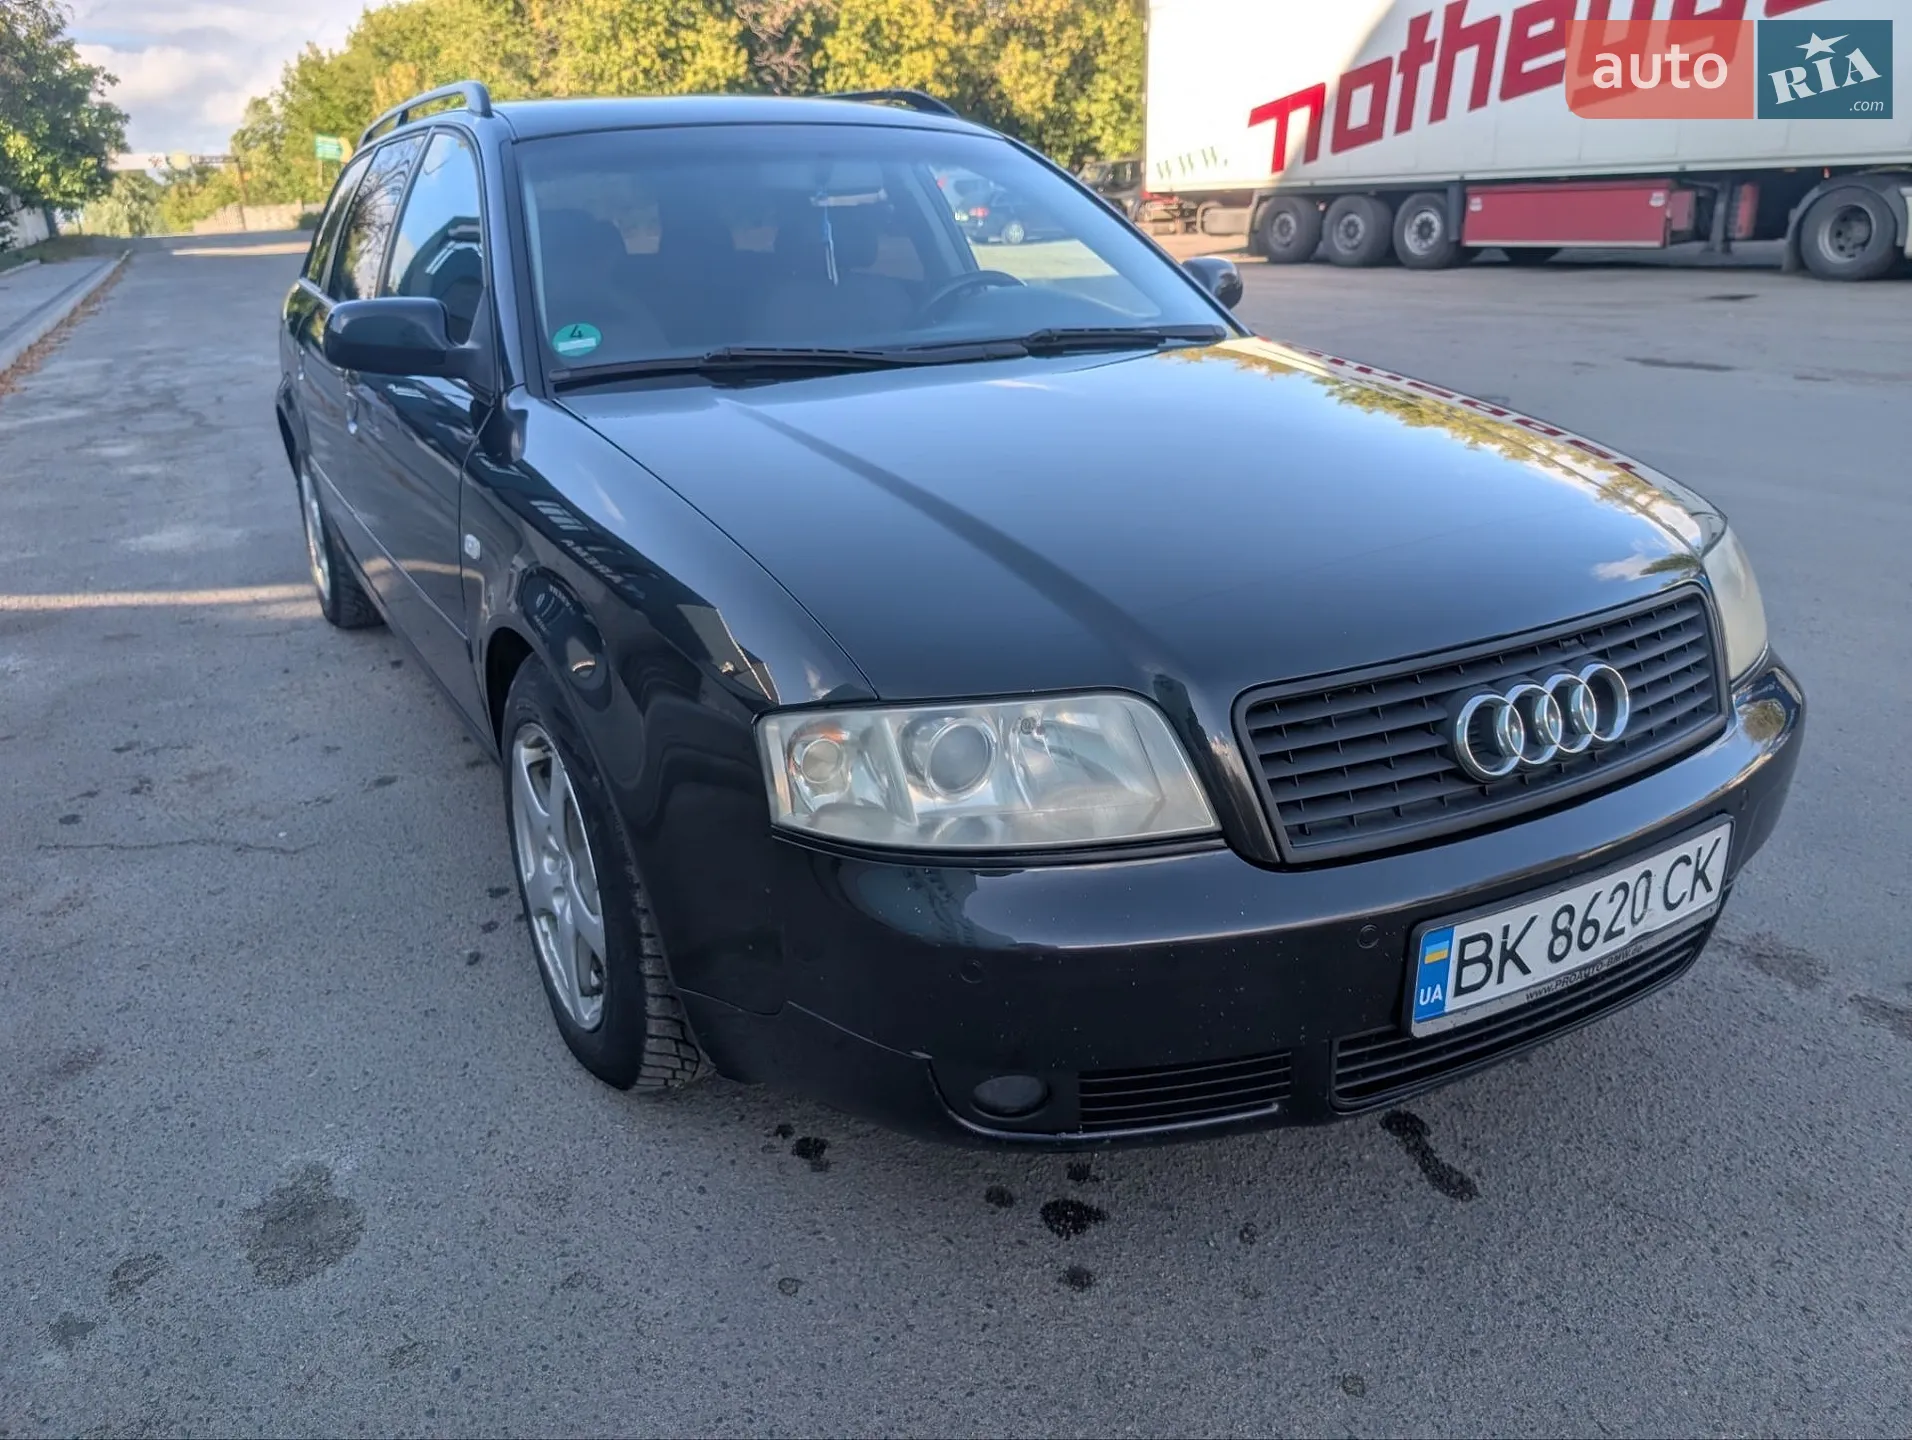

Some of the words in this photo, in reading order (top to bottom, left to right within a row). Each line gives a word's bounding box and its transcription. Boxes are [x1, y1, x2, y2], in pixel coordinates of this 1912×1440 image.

[569, 324, 583, 339] 4
[1453, 915, 1538, 997] BK
[1547, 869, 1652, 964] 8620
[1663, 837, 1722, 911] CK
[1419, 983, 1443, 1006] UA
